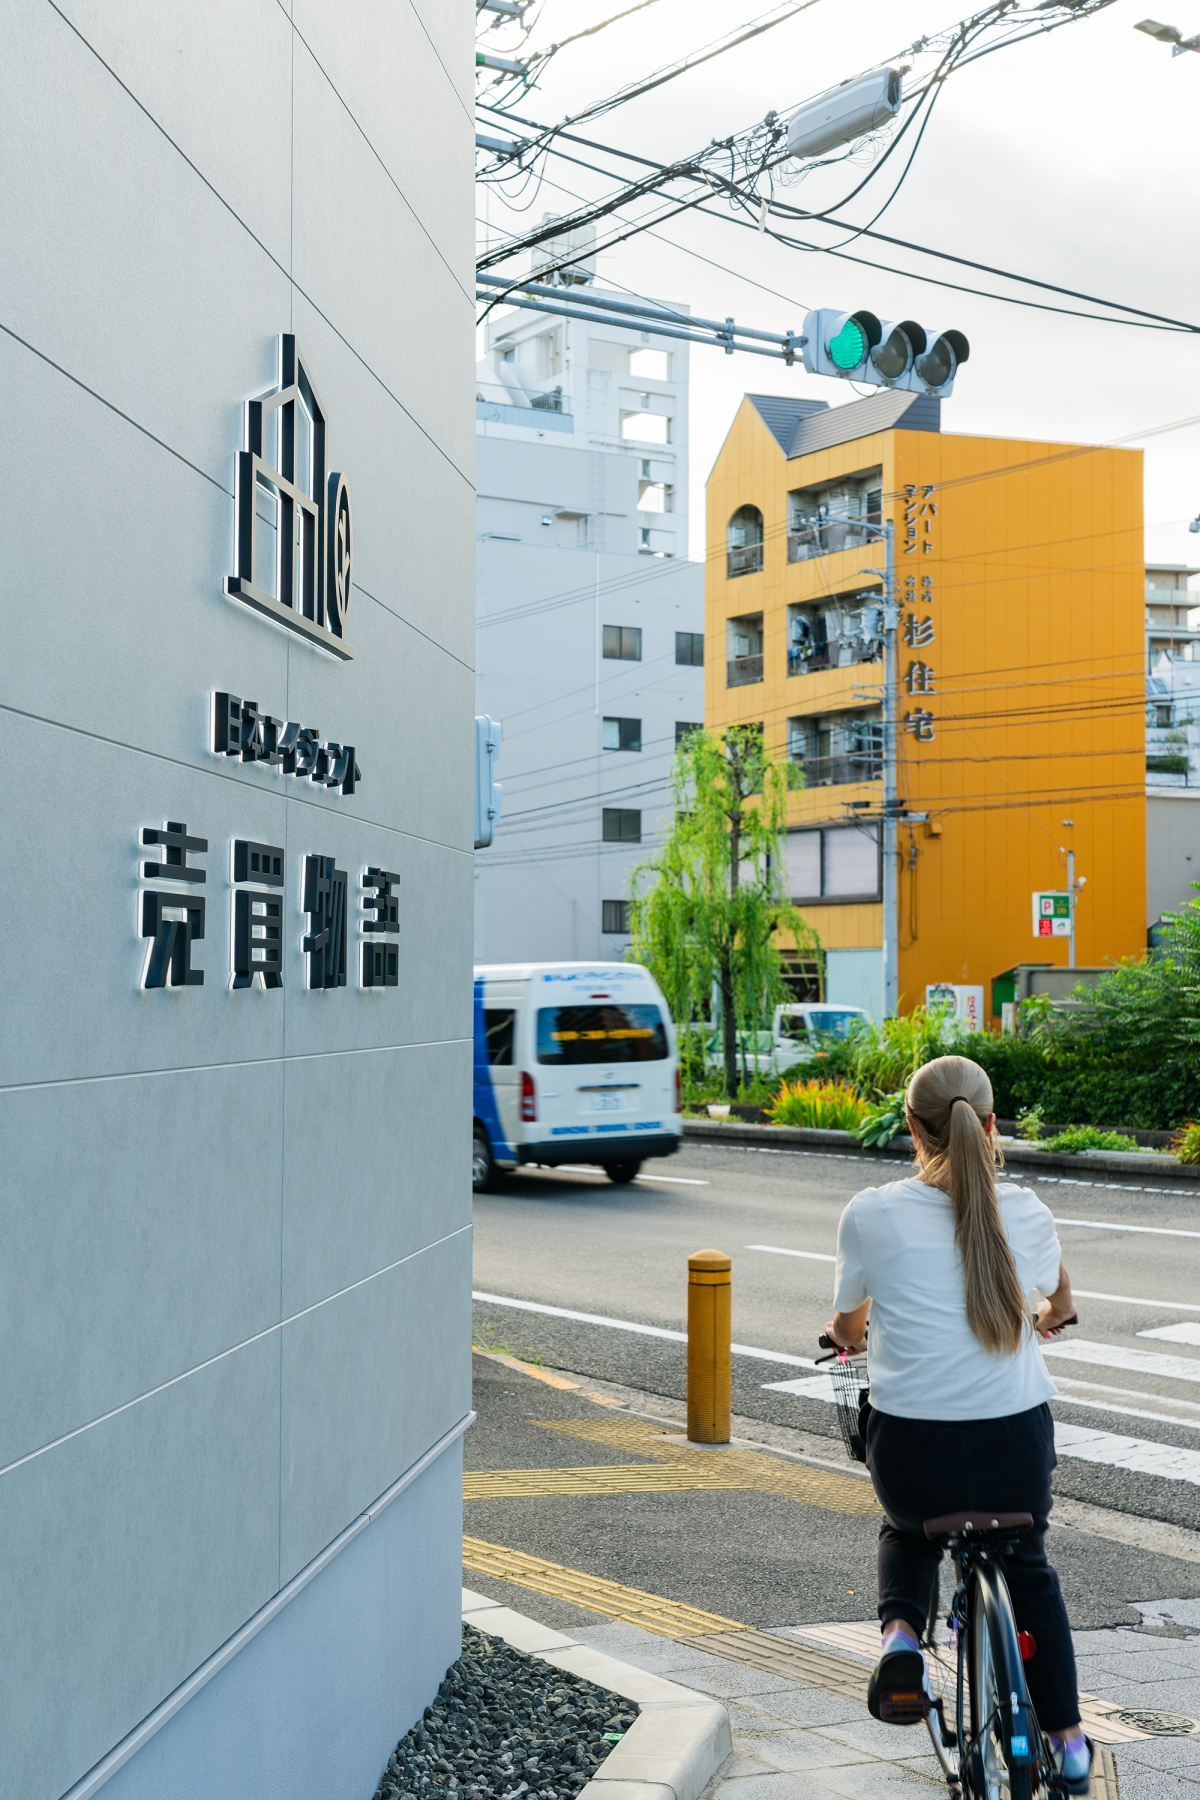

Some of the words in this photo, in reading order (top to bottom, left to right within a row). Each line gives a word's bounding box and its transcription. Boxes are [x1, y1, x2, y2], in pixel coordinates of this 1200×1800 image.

[904, 484, 918, 554] マンション
[921, 484, 938, 554] アパート
[904, 613, 937, 743] 杉住宅
[139, 821, 400, 989] 売買物語
[1044, 901, 1051, 913] P
